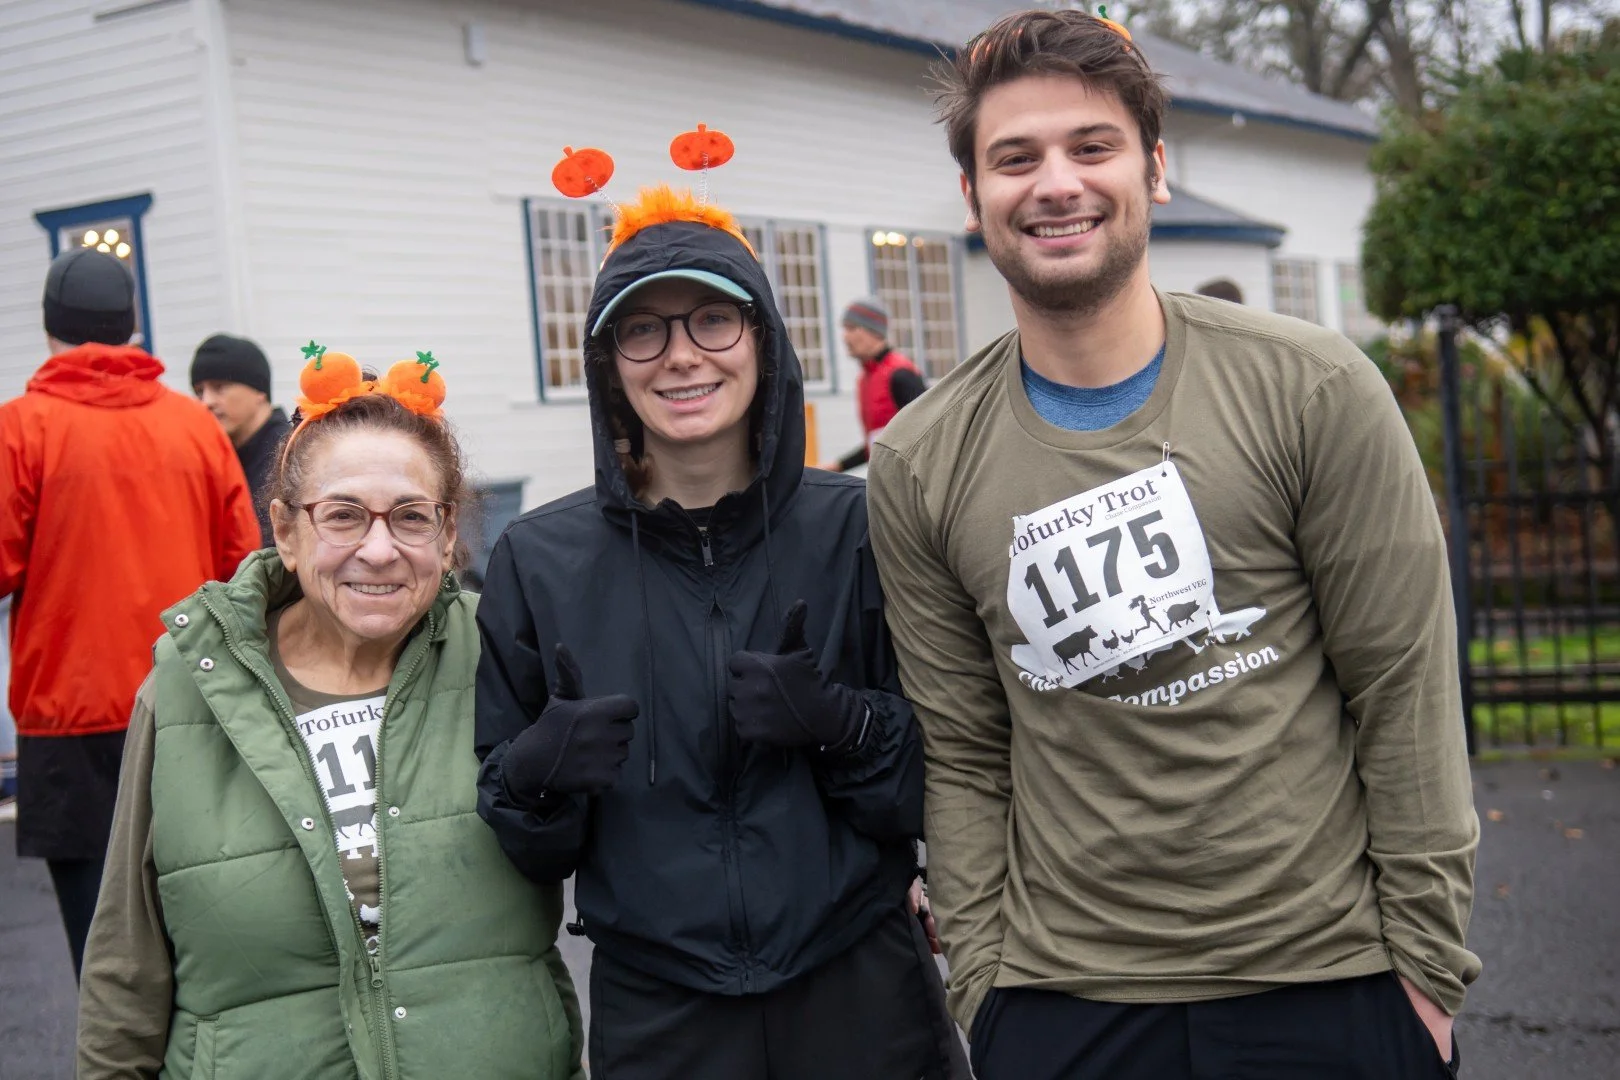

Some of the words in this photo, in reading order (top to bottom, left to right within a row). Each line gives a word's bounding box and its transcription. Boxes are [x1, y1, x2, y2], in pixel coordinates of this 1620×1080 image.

[1097, 479, 1158, 513] Trot
[1123, 495, 1162, 513] Compassion
[1024, 509, 1180, 629] 1175
[1148, 585, 1192, 605] Northwest
[1191, 578, 1207, 590] VEG
[300, 704, 384, 736] Tofurk
